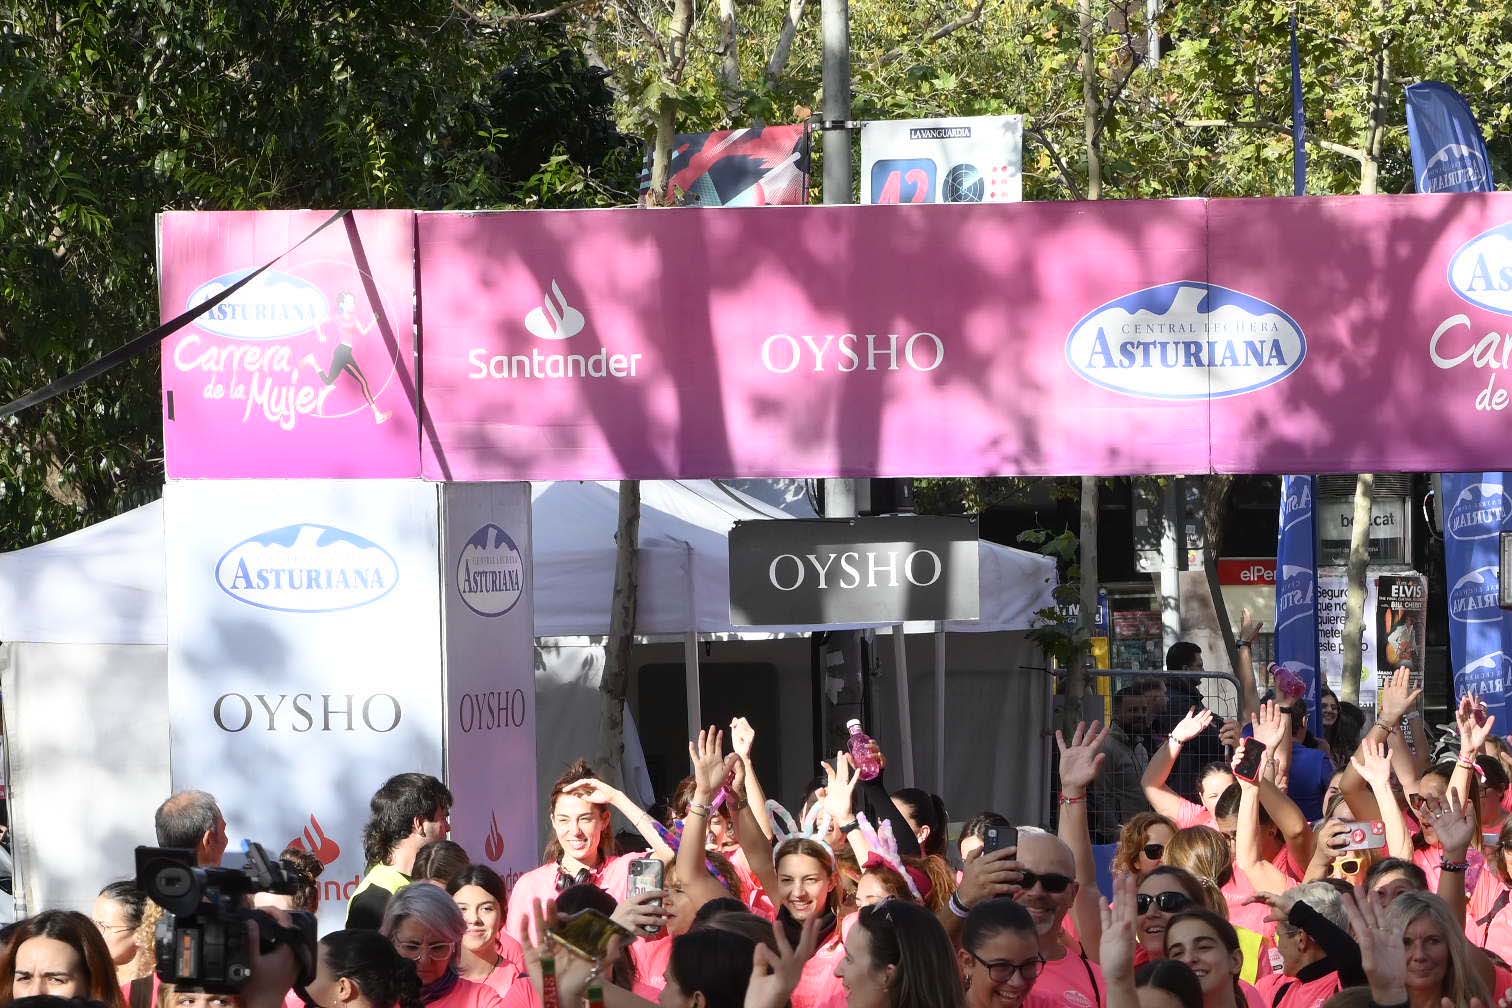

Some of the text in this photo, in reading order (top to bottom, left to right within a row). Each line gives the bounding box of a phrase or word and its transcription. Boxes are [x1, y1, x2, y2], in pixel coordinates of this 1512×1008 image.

[1121, 321, 1280, 334] CENTRAL LECHERA
[173, 335, 292, 373] Carrera
[468, 347, 642, 380] Santander
[761, 331, 945, 375] OYSHO
[1087, 326, 1288, 369] ASTURIANA
[203, 368, 337, 430] de la Mujer
[1475, 373, 1510, 412] de
[1340, 512, 1395, 528] b.cat
[229, 556, 386, 591] ASTURIANA
[463, 558, 521, 594] ASTURIANA
[769, 549, 942, 591] OYSHO
[1391, 585, 1422, 598] ELVIS
[213, 692, 402, 733] OYSHO
[460, 687, 526, 734] OYSHO
